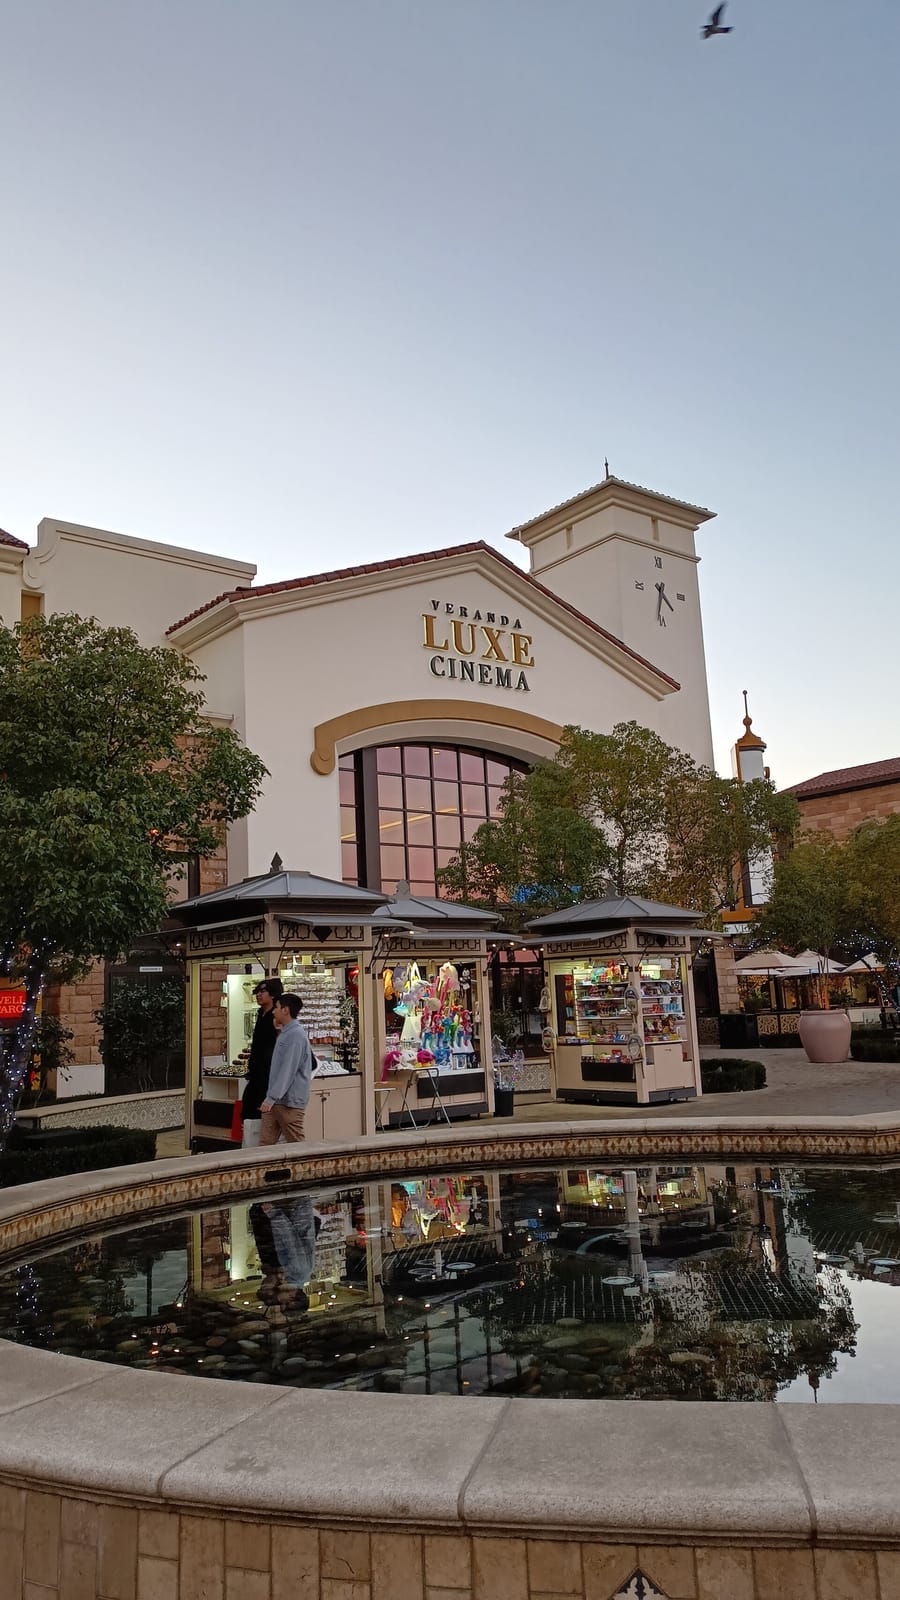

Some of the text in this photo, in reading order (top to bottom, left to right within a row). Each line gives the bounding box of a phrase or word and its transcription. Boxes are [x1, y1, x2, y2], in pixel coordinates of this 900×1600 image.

[431, 600, 522, 629] VERANDA
[422, 613, 535, 667] LUXE
[430, 655, 531, 692] CINEMA
